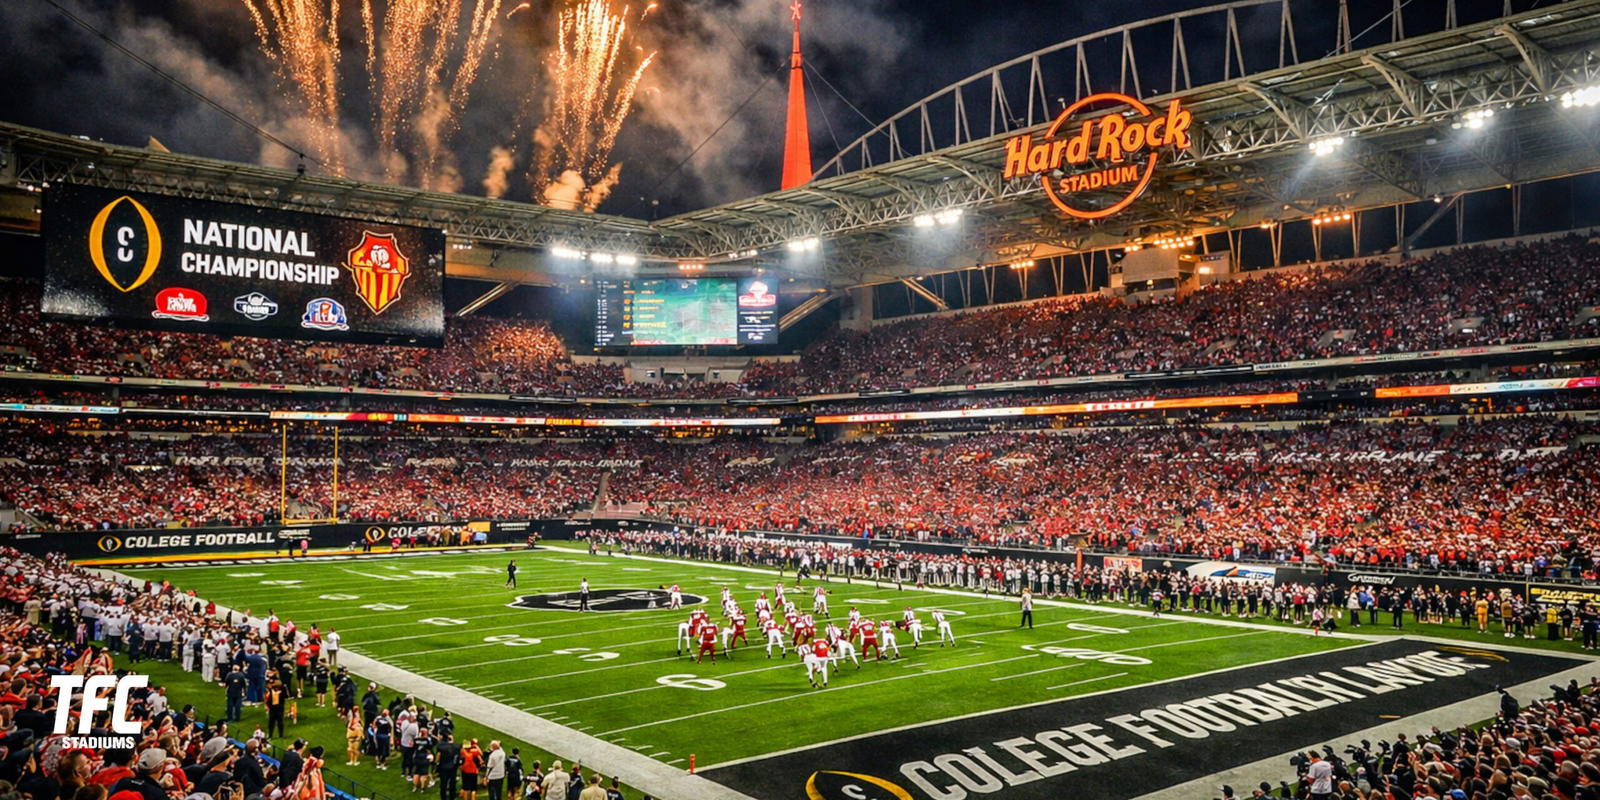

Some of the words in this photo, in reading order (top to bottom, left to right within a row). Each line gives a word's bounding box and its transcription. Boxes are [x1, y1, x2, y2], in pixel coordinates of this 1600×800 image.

[1003, 120, 1094, 179] Hard
[1096, 99, 1192, 163] Rock
[1059, 165, 1139, 194] STADIUM
[183, 218, 316, 257] NATIONAL
[181, 252, 340, 285] CHAMPIONSHIP
[125, 534, 192, 549] COLEGE
[194, 532, 276, 546] FOOTBALL
[900, 722, 1148, 800] COLEGE
